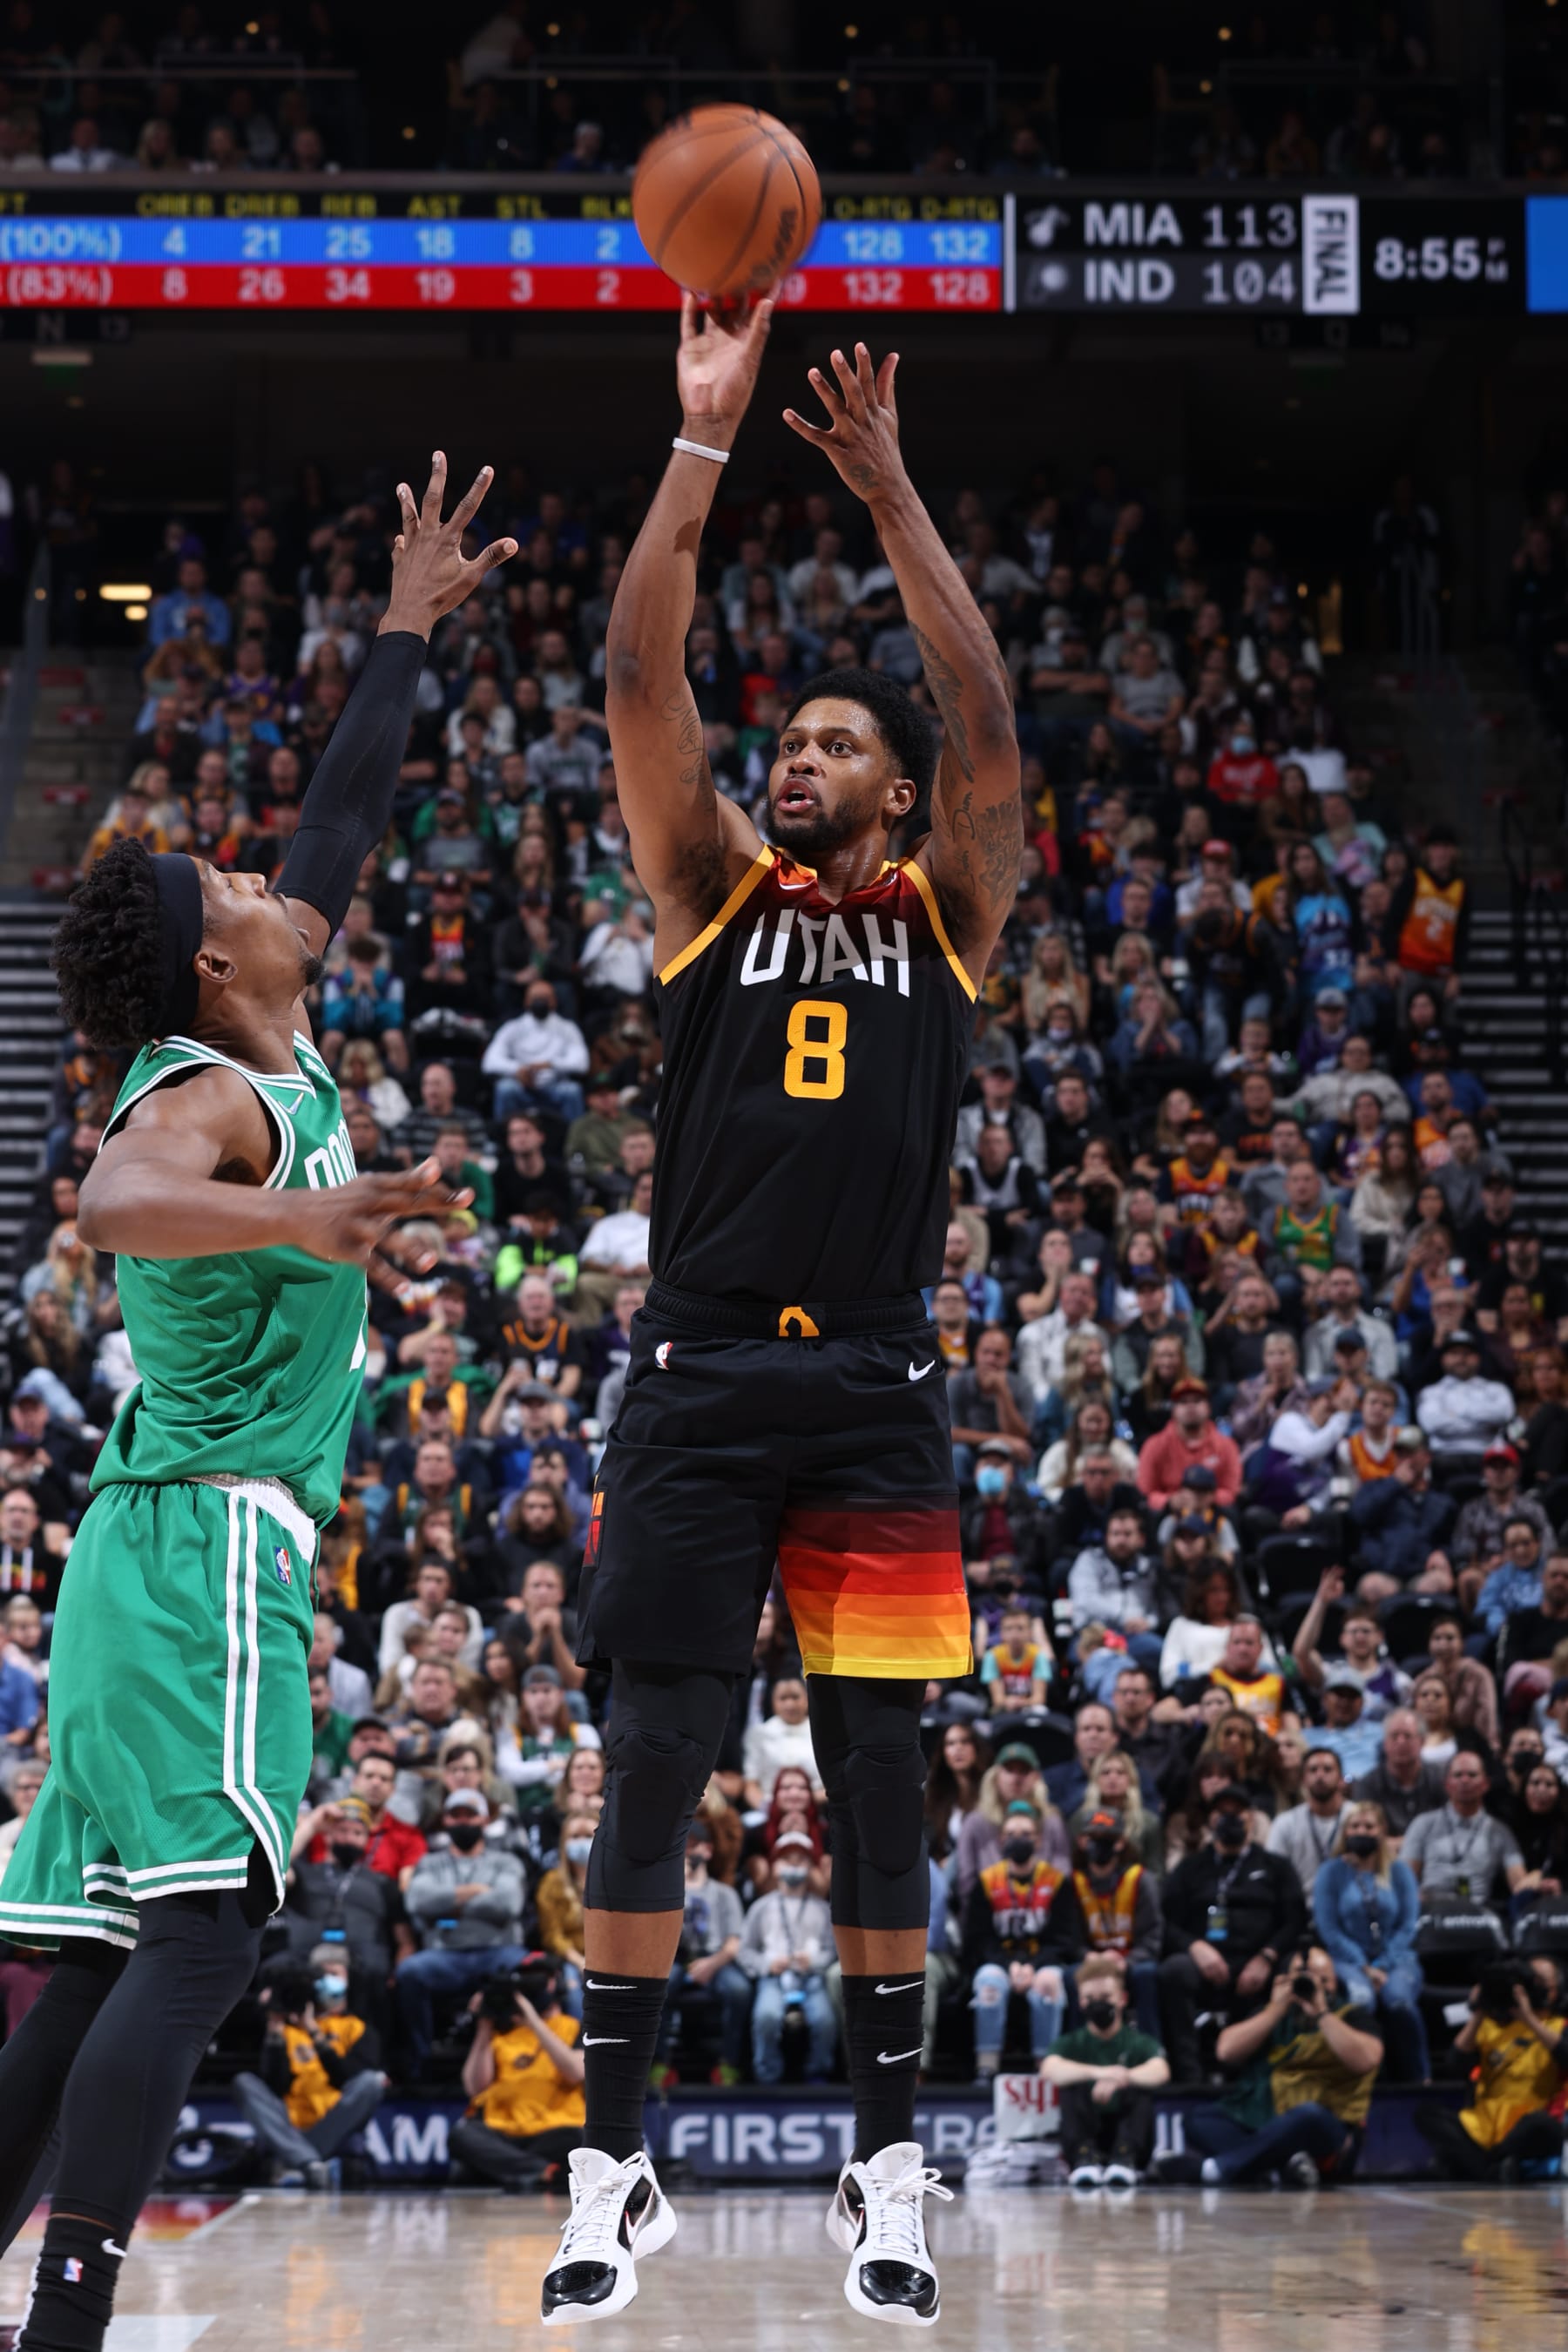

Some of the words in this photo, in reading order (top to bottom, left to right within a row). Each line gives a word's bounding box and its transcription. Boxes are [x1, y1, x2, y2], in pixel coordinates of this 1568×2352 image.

[137, 193, 214, 218] OREB
[224, 193, 301, 218] DREB
[321, 193, 376, 218] REB
[407, 194, 462, 219] AST
[496, 194, 548, 219] STL
[1084, 202, 1183, 247] MIA
[1203, 203, 1297, 247] 113
[1, 223, 122, 263] (100%)
[163, 226, 186, 257] 4
[241, 226, 282, 258] 21
[325, 226, 372, 259] 25
[415, 226, 455, 258] 18
[510, 226, 534, 259] 8
[597, 226, 620, 260] 2
[842, 227, 904, 260] 128
[929, 227, 989, 260] 132
[1312, 206, 1349, 303] FINAL
[1374, 238, 1483, 280] 8:55
[7, 266, 113, 305] (83%)
[163, 268, 186, 301] 8
[238, 268, 285, 301] 26
[326, 268, 371, 301] 34
[416, 268, 456, 302] 19
[510, 271, 534, 304] 3
[597, 271, 620, 304] 2
[842, 272, 904, 304] 132
[929, 272, 990, 304] 128
[1085, 260, 1175, 302] IND
[1203, 260, 1297, 303] 104
[740, 909, 909, 997] UTAH
[784, 1000, 848, 1100] 8
[669, 2113, 857, 2165] FIRST
